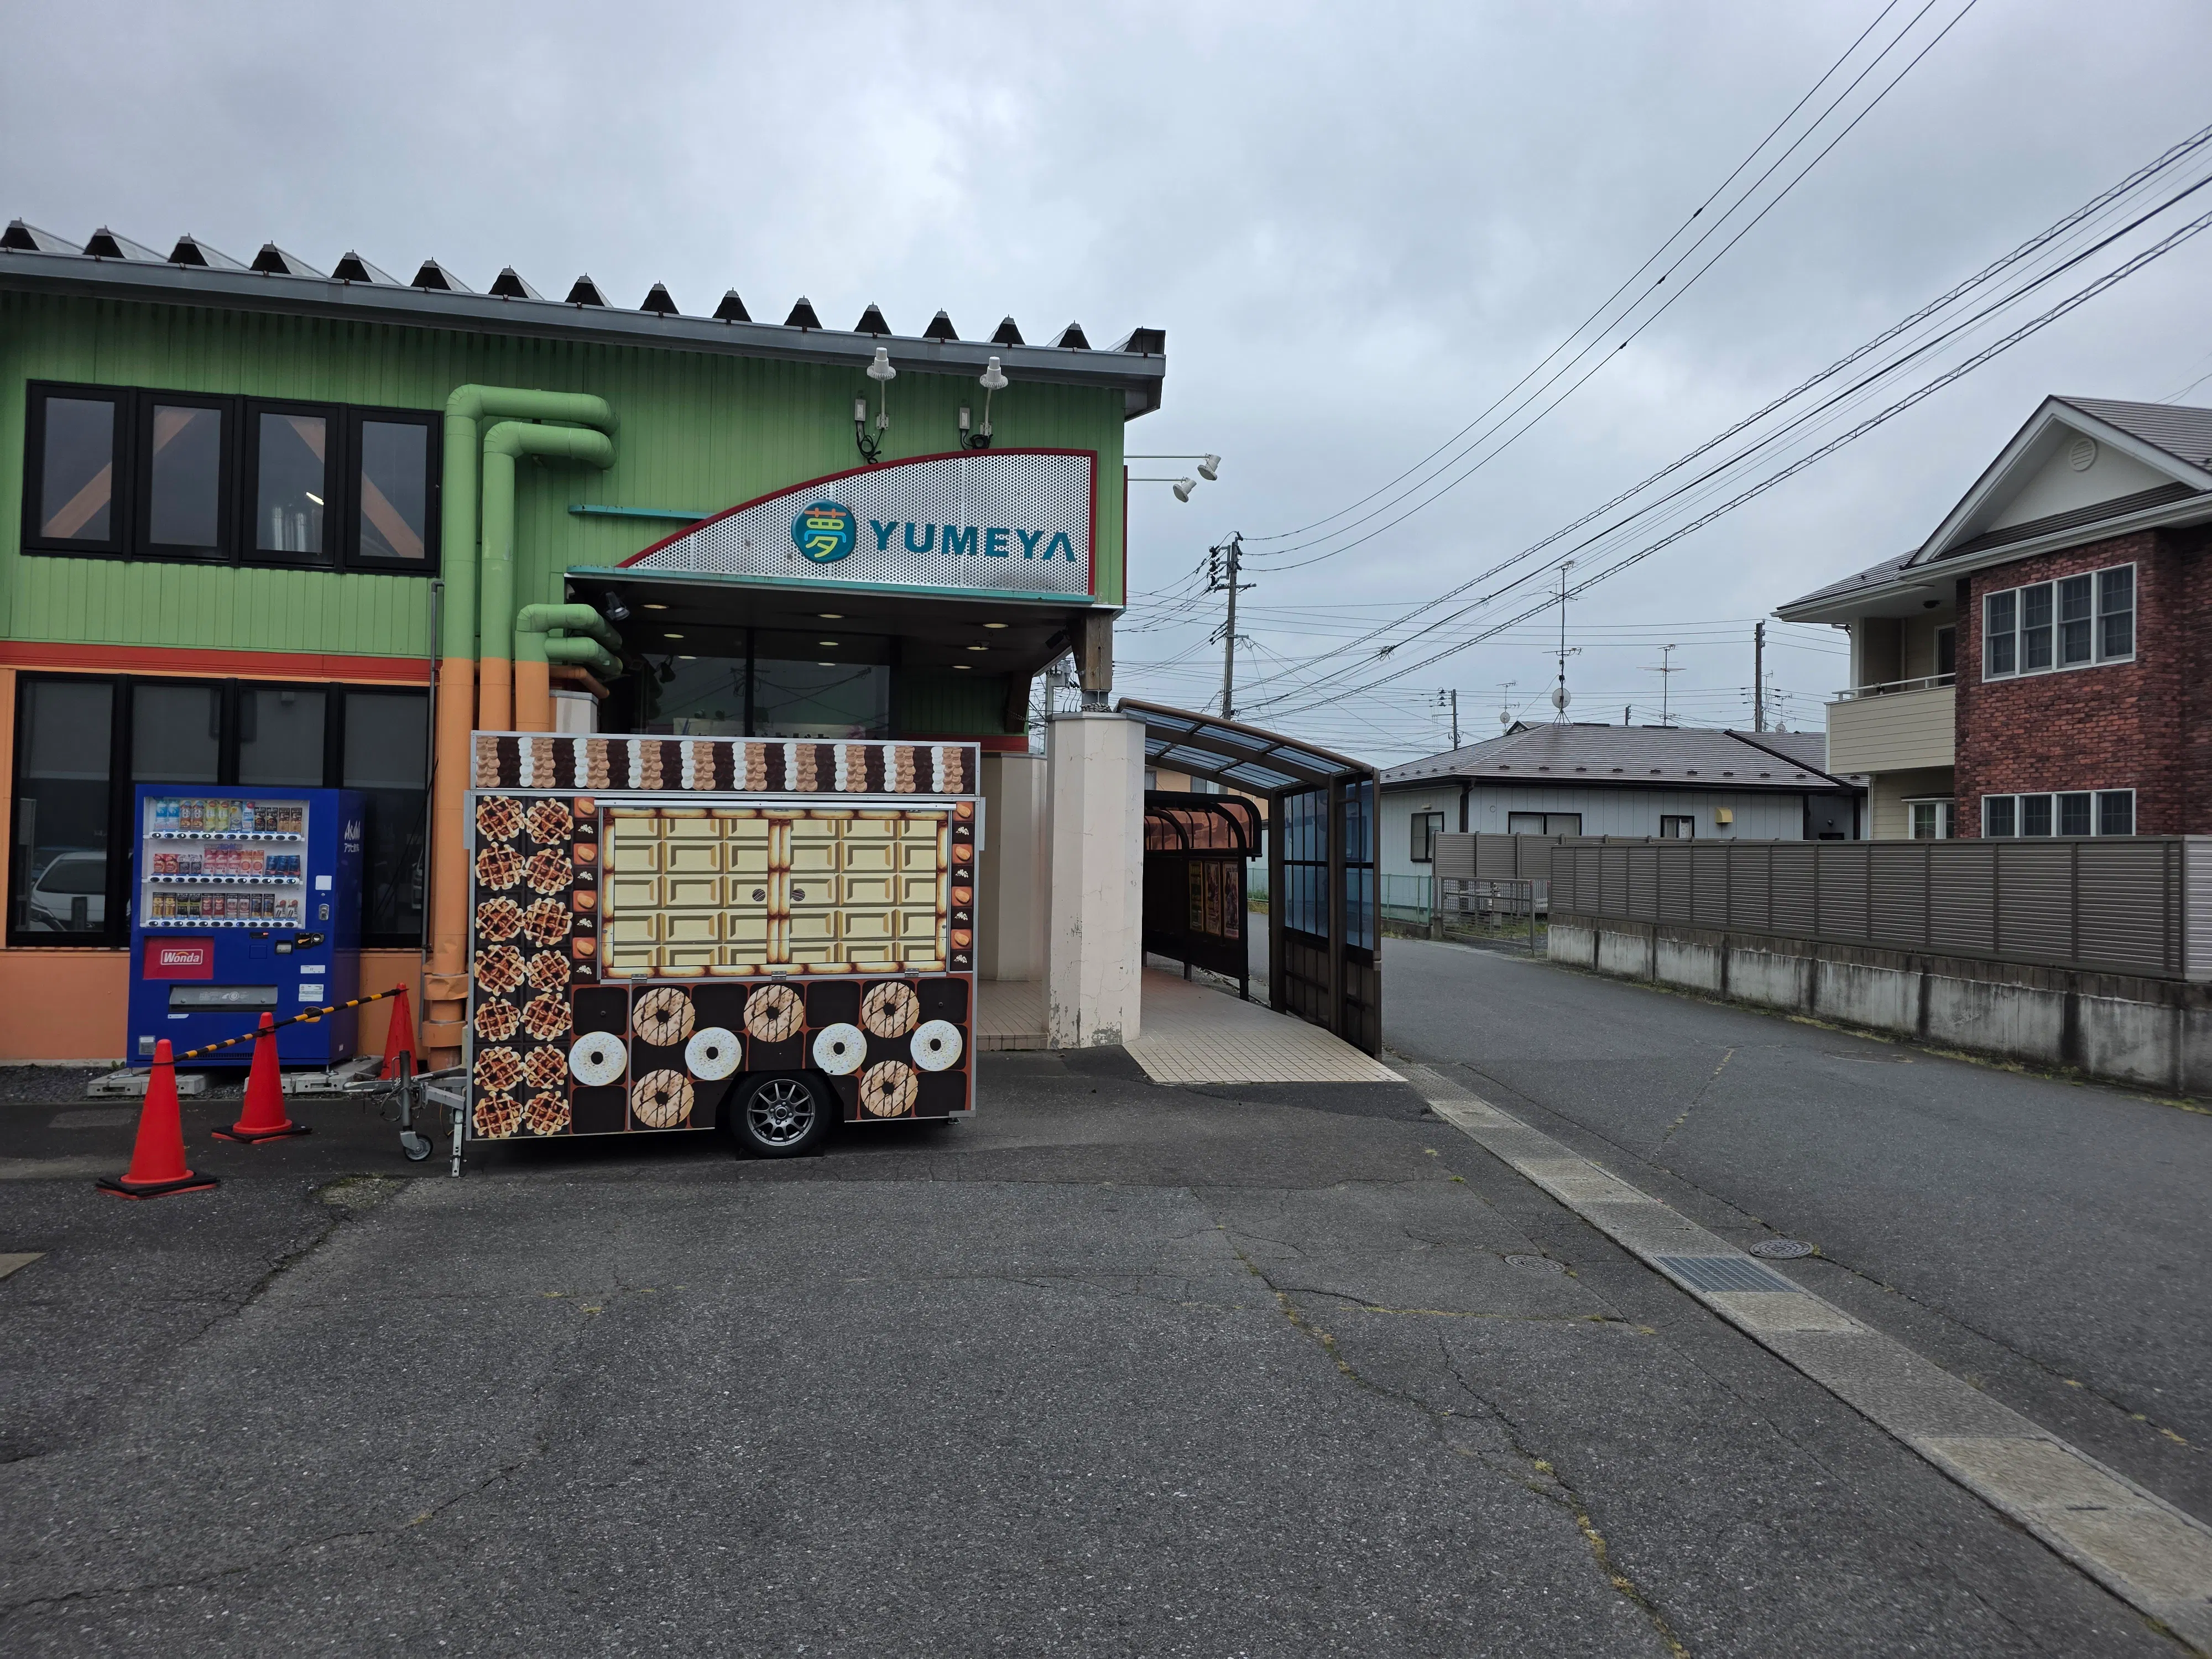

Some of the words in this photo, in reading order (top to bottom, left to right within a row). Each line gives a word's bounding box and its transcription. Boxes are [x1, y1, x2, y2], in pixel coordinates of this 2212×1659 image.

[804, 507, 847, 558] 夢
[869, 519, 1077, 562] YUMEYA
[164, 952, 200, 963] Wonda
